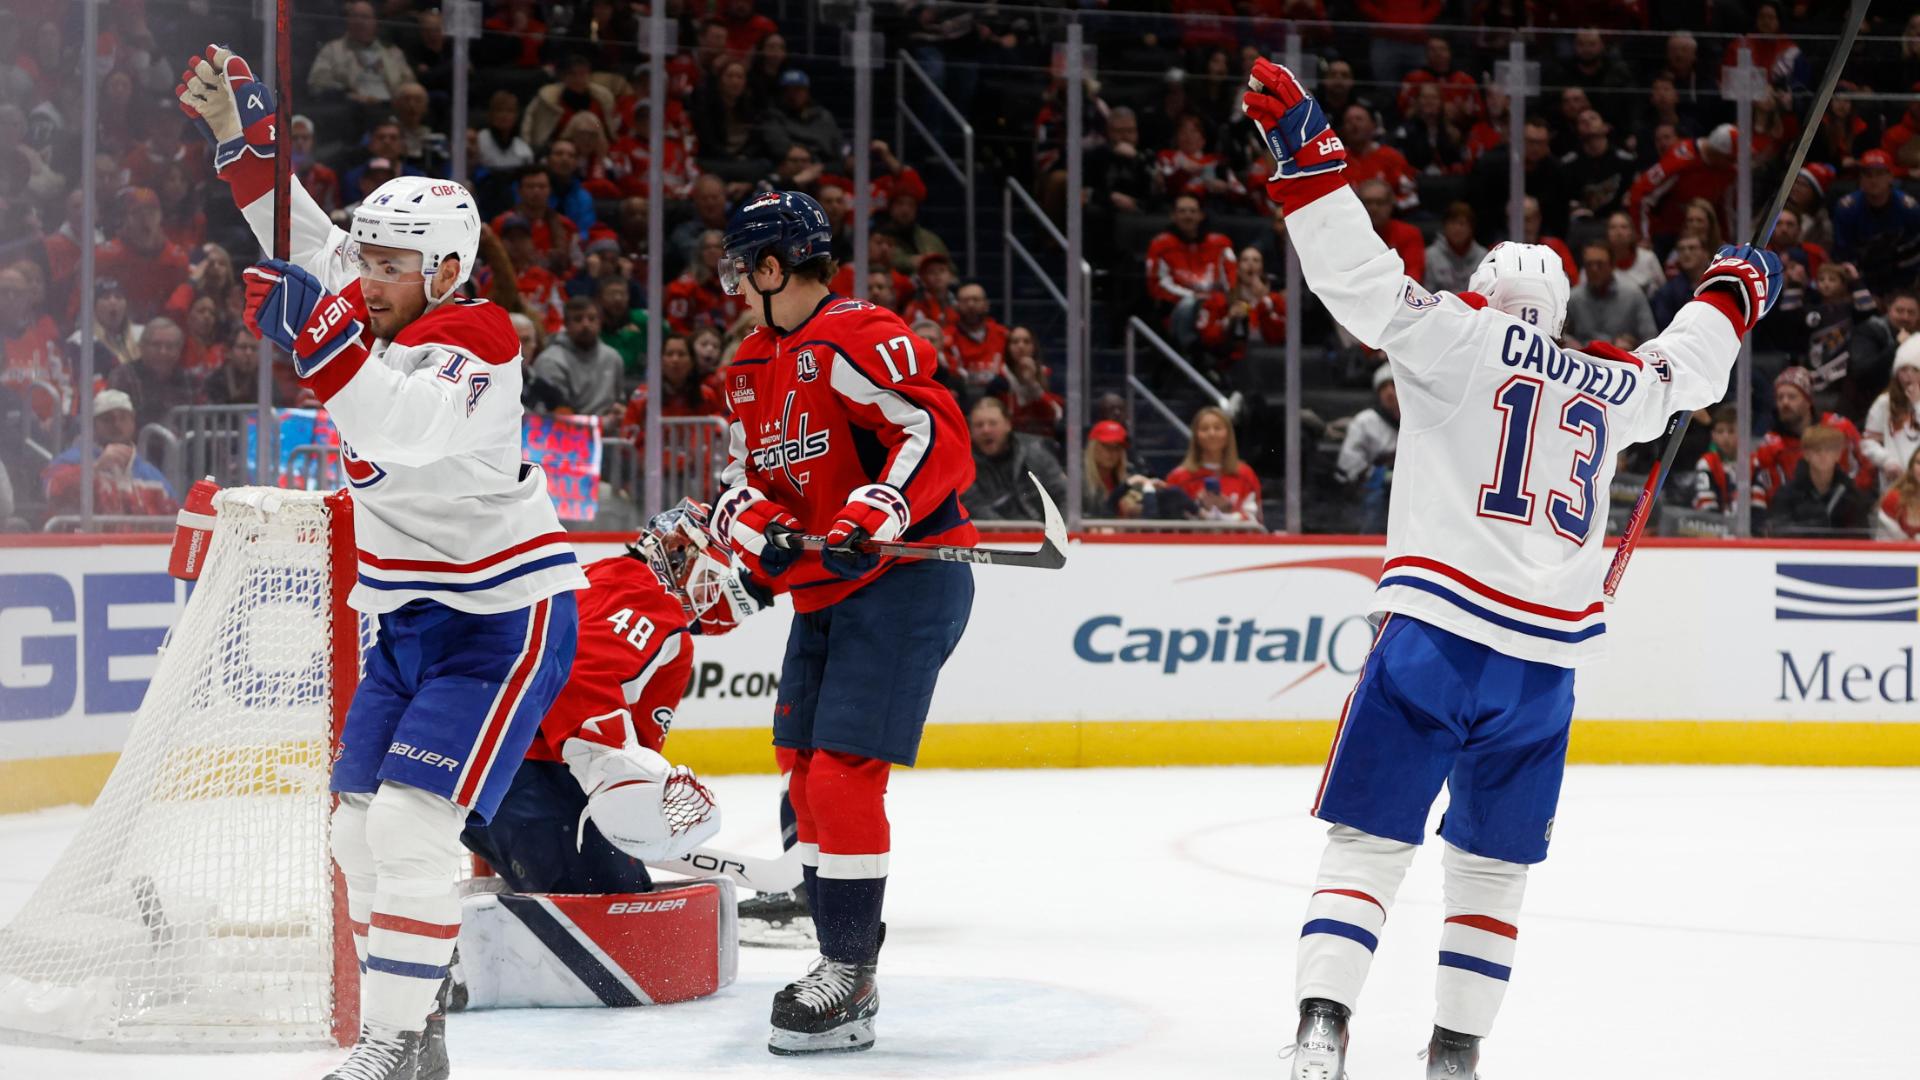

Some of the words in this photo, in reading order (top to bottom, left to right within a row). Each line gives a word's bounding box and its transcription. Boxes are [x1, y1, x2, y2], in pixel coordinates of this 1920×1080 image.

[1520, 307, 1539, 326] 13
[874, 335, 918, 384] 17
[1501, 324, 1637, 406] CAUFIELD
[437, 352, 492, 418] 14
[1476, 374, 1610, 548] 13
[185, 529, 201, 574] BODYARMOR
[939, 547, 992, 564] CCM
[727, 578, 754, 617] AUER
[607, 607, 656, 652] 48
[1776, 646, 1914, 703] Med
[388, 742, 460, 772] BAUER
[607, 898, 687, 914] BAUER
